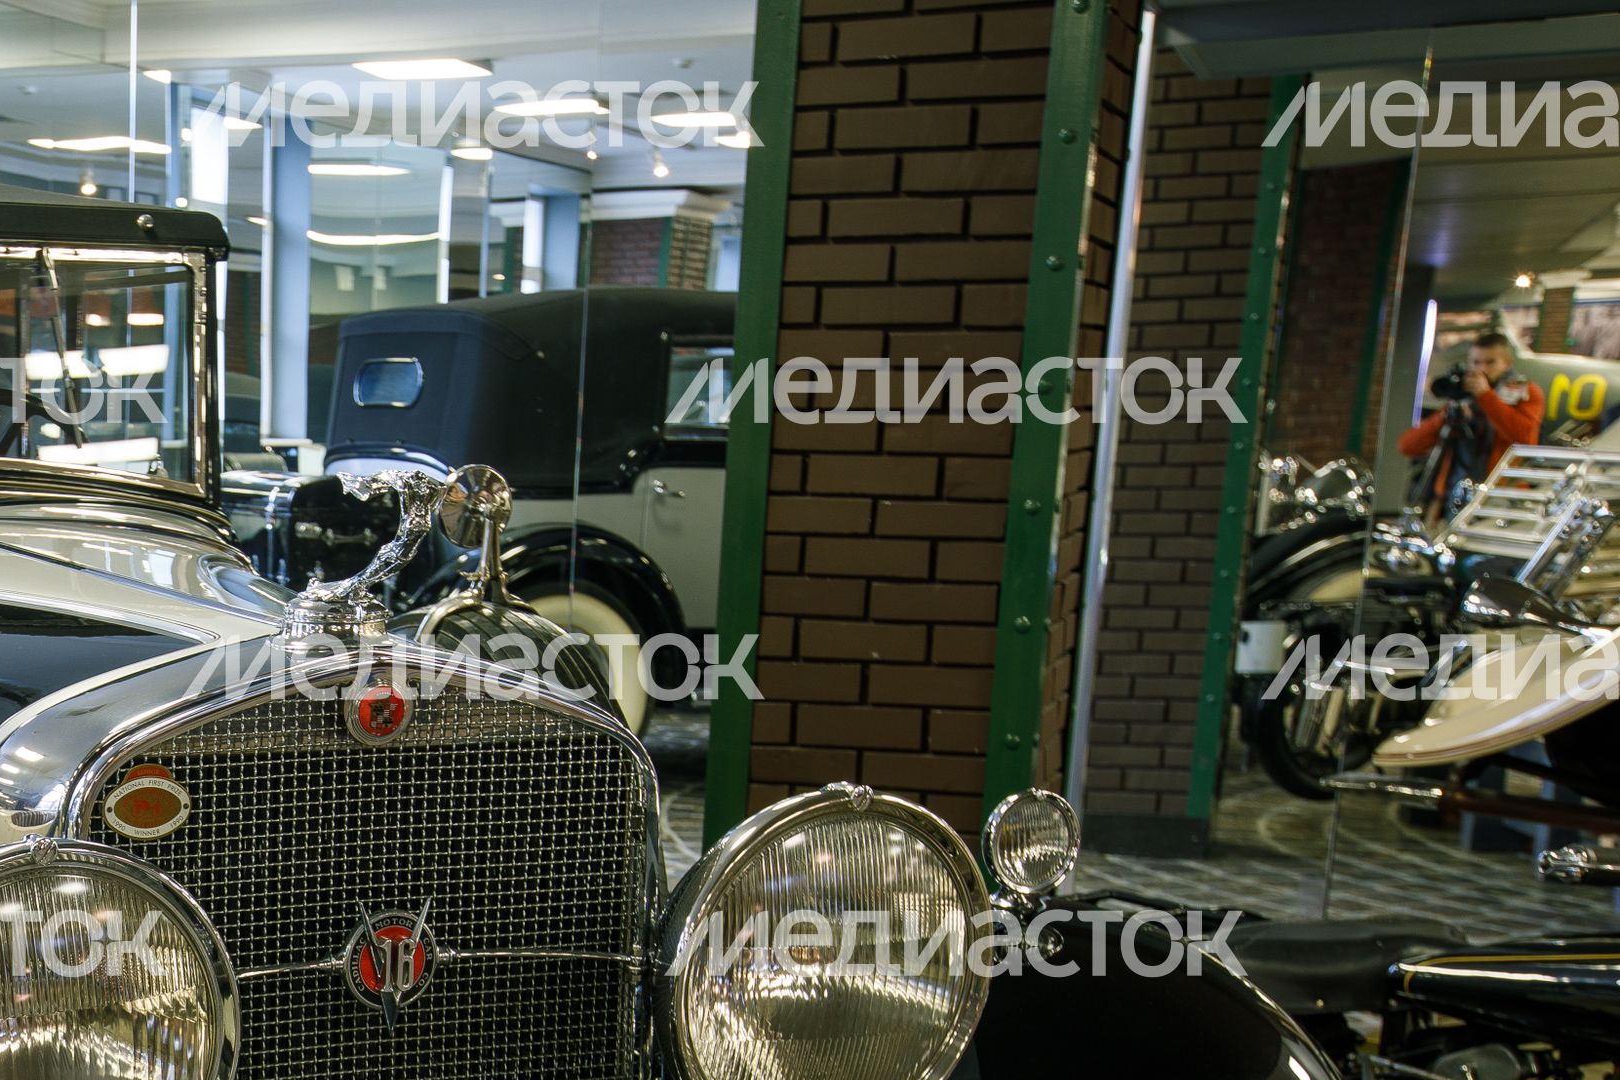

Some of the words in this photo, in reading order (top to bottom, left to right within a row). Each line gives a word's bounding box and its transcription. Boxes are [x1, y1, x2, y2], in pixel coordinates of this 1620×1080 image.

[113, 782, 145, 799] NATIONAL
[167, 783, 183, 797] PRIZE
[134, 828, 160, 836] WINNER
[351, 937, 366, 992] CADILLAC
[374, 918, 413, 929] MOTOR
[422, 937, 433, 960] CAR
[379, 938, 415, 993] 16
